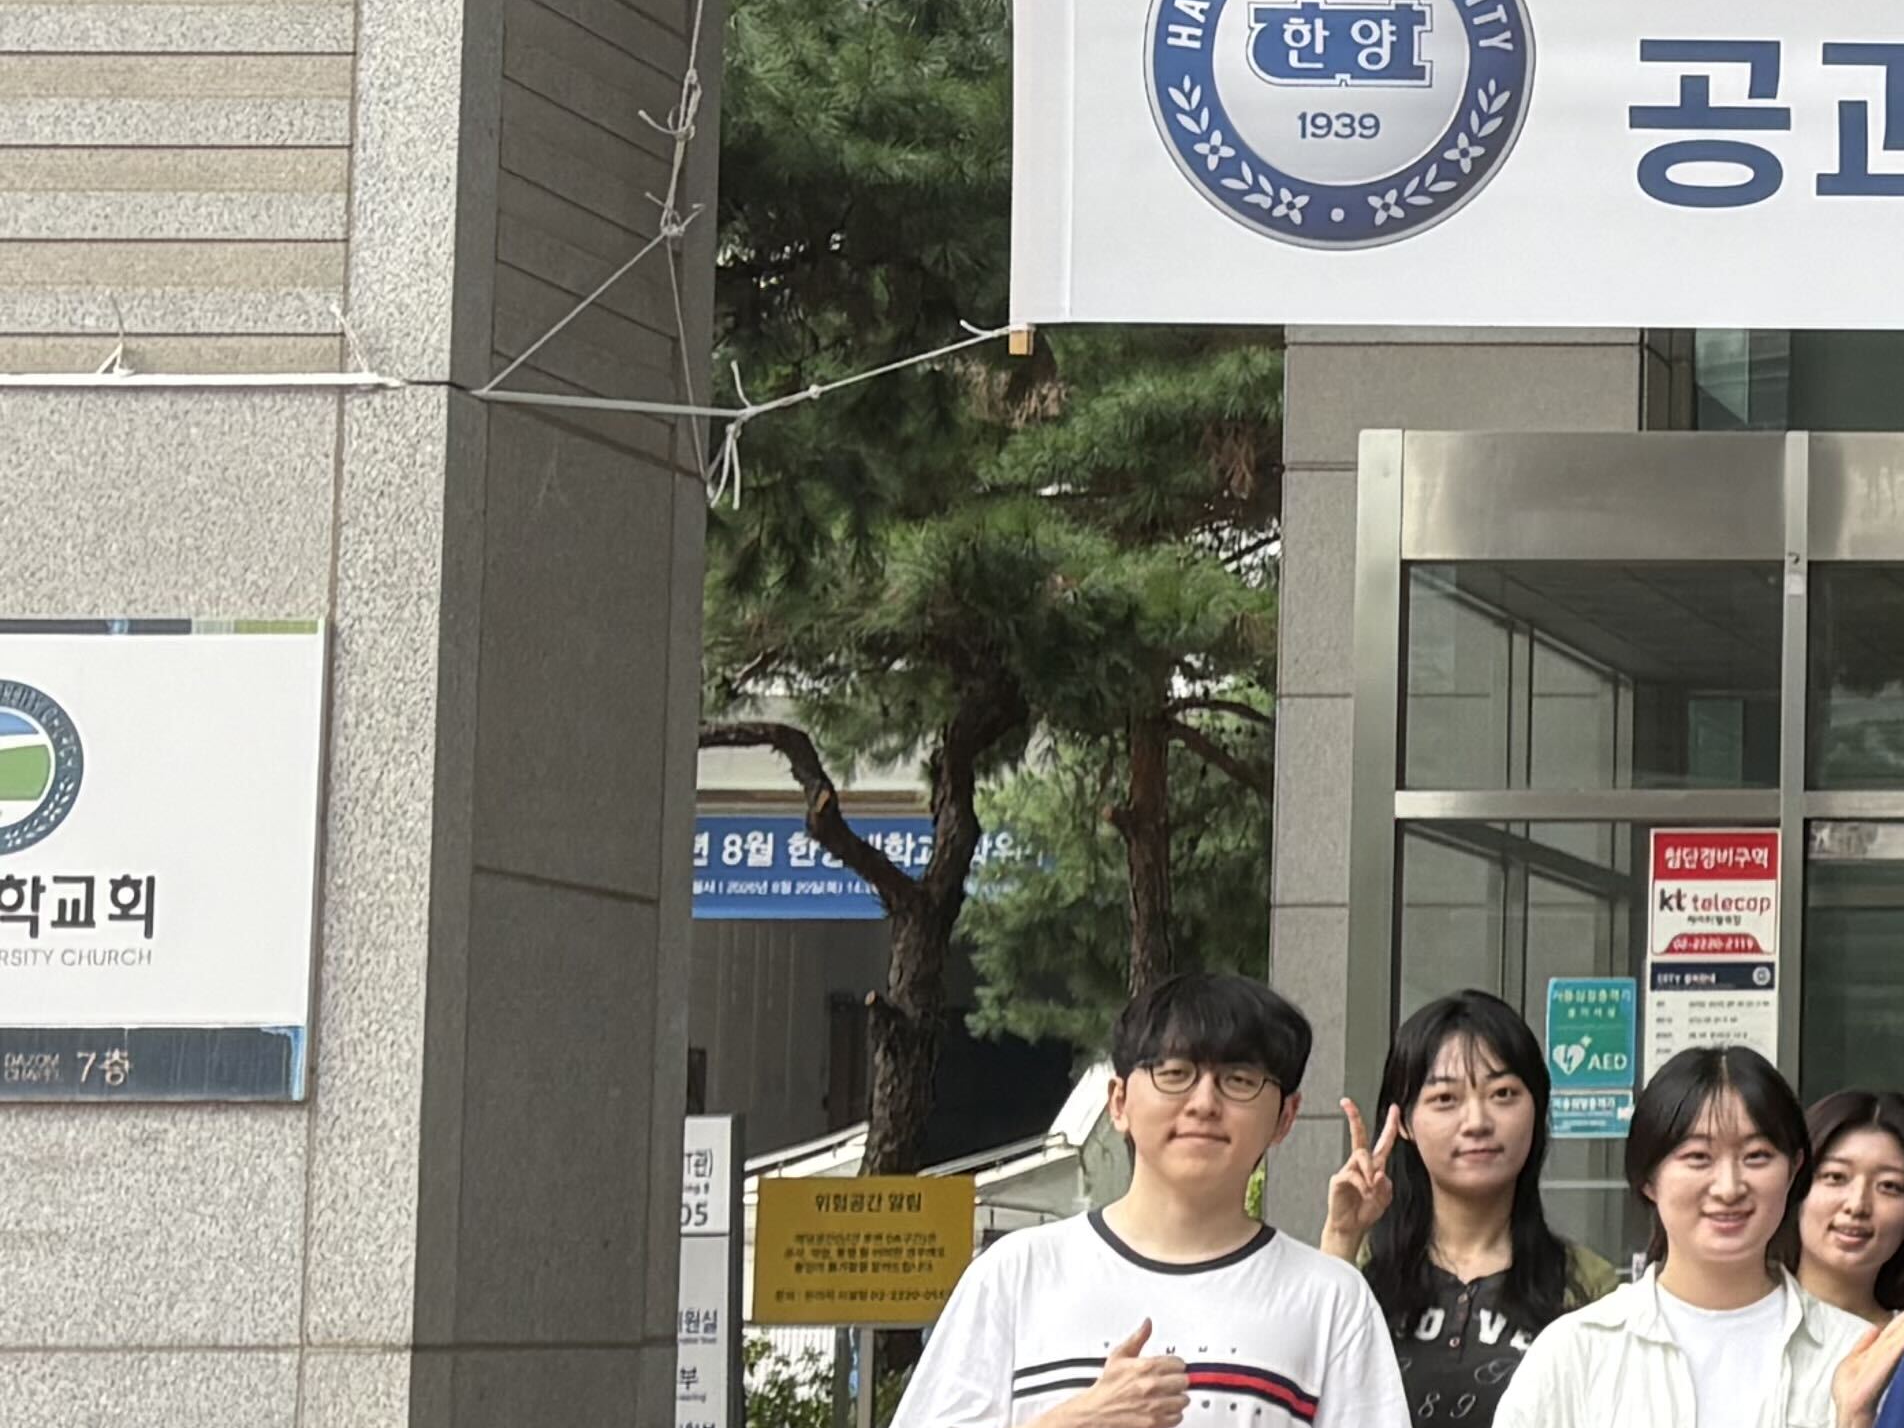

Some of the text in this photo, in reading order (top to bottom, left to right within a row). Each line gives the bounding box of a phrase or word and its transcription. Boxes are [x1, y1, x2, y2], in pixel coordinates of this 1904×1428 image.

[1299, 112, 1380, 139] 1939
[721, 830, 774, 868] 8월
[1659, 887, 1685, 913] kt
[61, 948, 153, 967] CHURCH
[1586, 1054, 1629, 1071] AED
